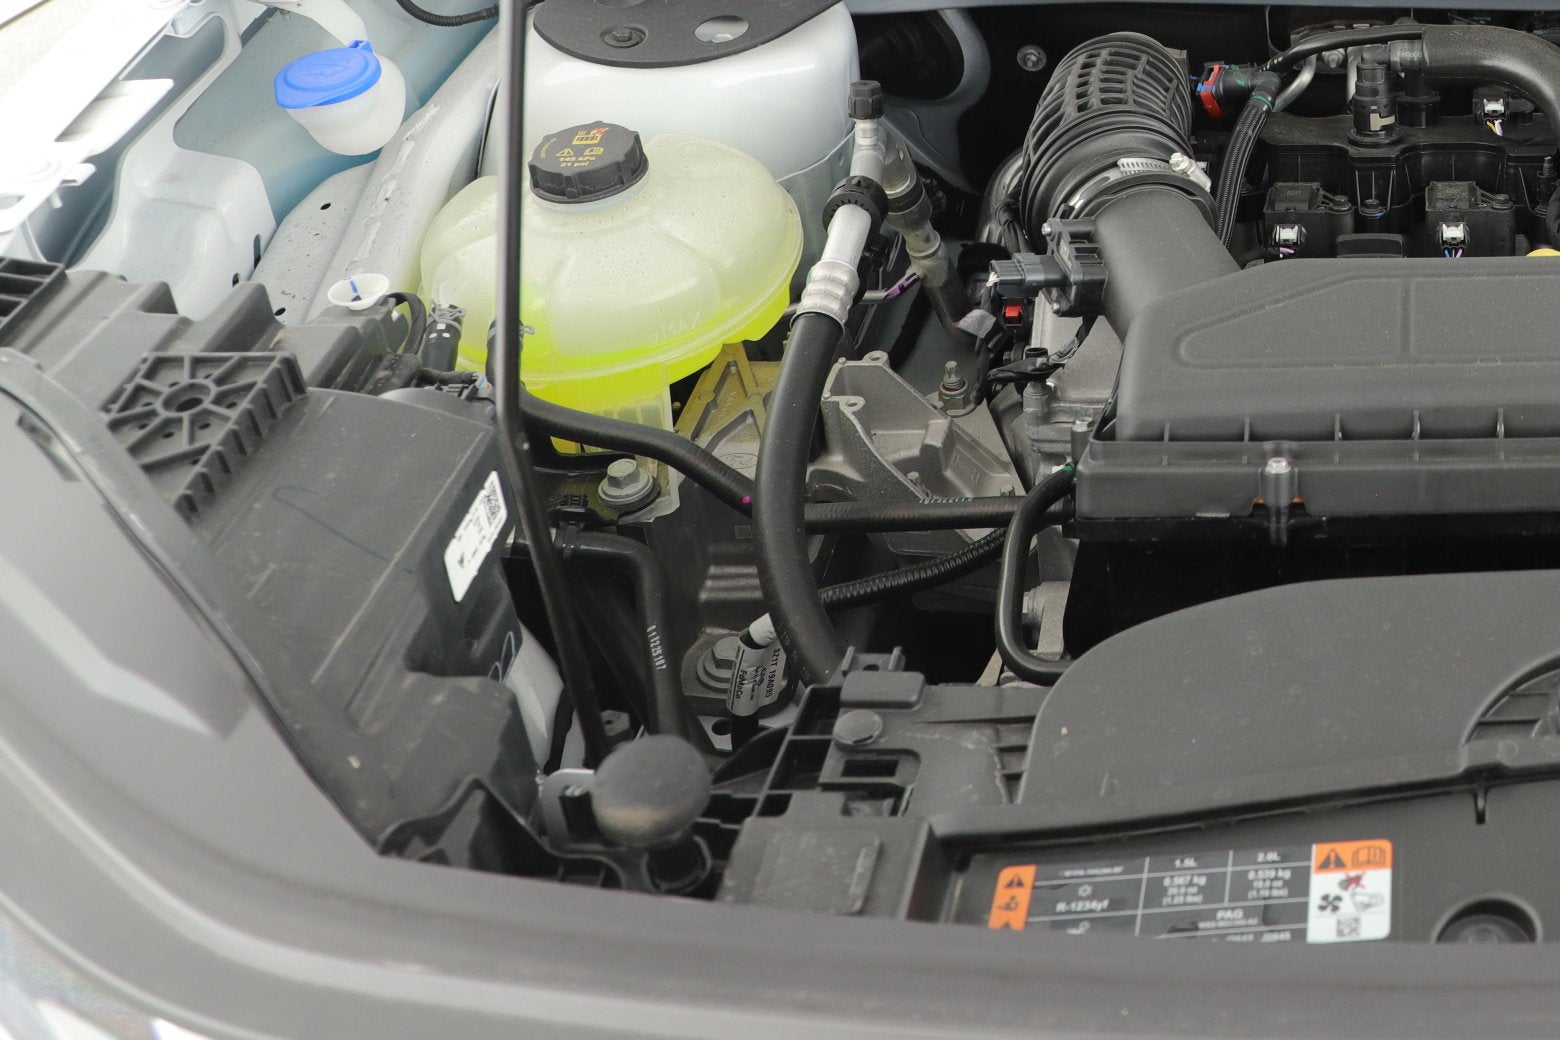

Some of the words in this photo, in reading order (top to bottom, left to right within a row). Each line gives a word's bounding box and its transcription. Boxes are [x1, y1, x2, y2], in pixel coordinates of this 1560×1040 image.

[735, 669, 748, 699] FoMoCo
[1055, 898, 1110, 913] R-1234yf
[1215, 908, 1244, 921] PAG
